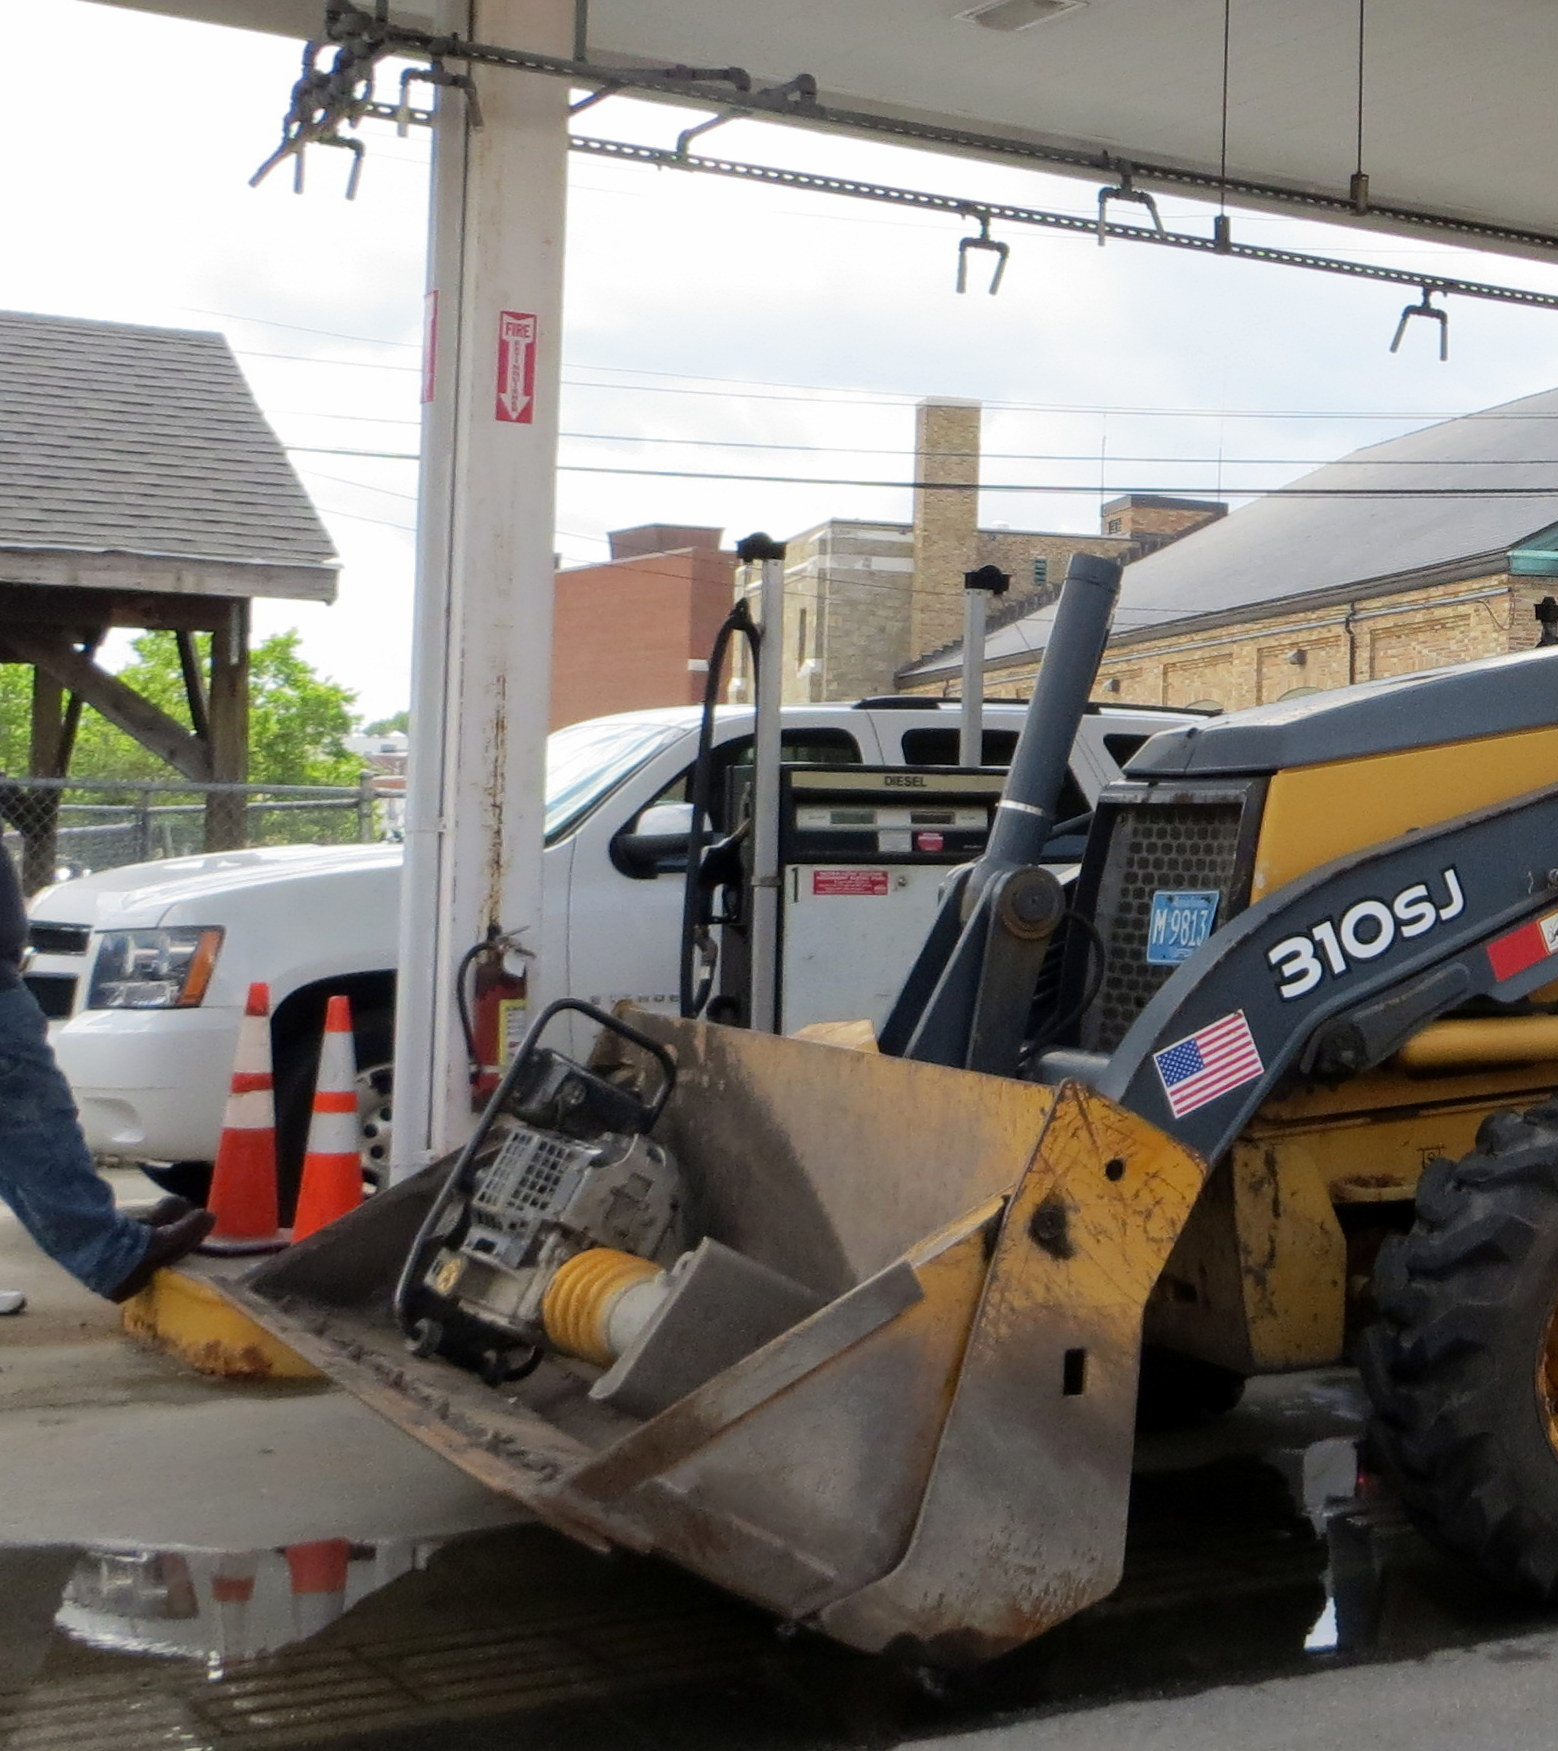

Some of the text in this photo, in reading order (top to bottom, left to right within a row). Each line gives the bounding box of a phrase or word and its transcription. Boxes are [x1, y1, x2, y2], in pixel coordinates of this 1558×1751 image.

[505, 322, 531, 338] FIRE
[884, 776, 927, 787] DIESEL
[791, 867, 799, 903] 1
[1268, 868, 1464, 998] 310SJ
